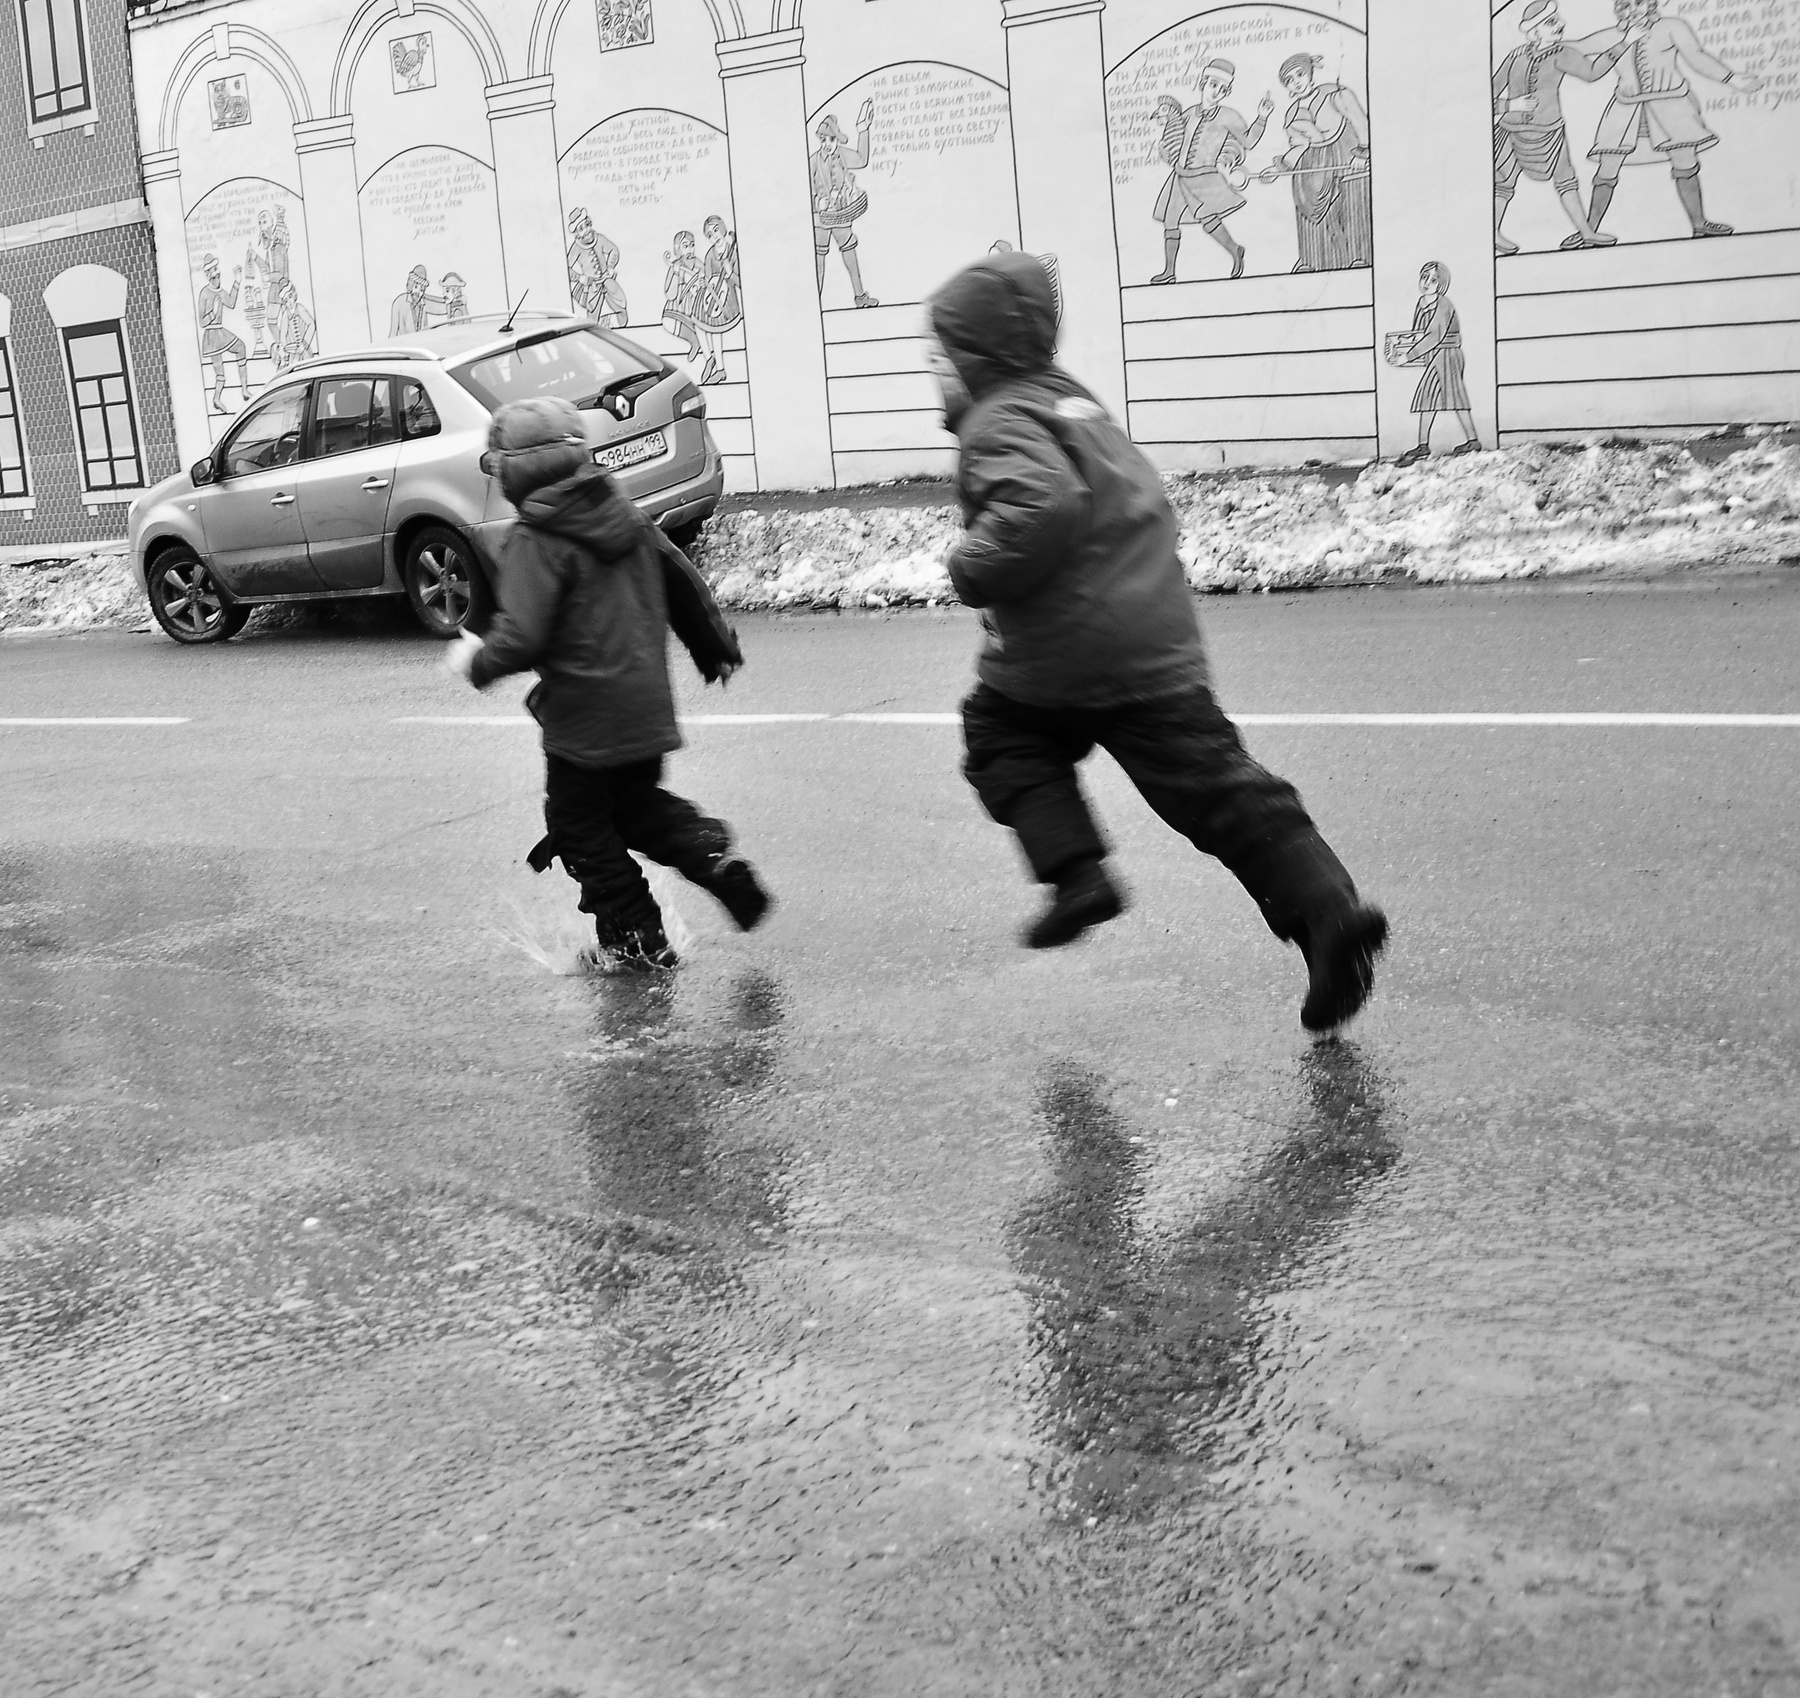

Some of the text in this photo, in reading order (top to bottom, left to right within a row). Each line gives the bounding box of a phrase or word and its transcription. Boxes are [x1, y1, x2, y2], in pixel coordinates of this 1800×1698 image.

[1195, 13, 1273, 37] КАШИРСКОЙ
[1698, 10, 1752, 30] ДОМА
[1761, 5, 1785, 20] НИ
[1703, 20, 1786, 46] НИ СЮДА
[1142, 21, 1330, 67] УЛИЦЕ МУЖИКИ ЛЮБЯТ В ГОС
[1719, 43, 1765, 59] ЛЬШЕ
[1114, 71, 1130, 81] ТИ
[1745, 58, 1767, 73] НЕ
[892, 70, 931, 85] БАБЬЕМ
[1109, 73, 1200, 96] СОСЕДОК КАШУ
[1763, 72, 1799, 88] ТАК
[875, 77, 974, 101] РЫНКЕ ЗАМОРСКИЕ
[876, 90, 992, 115] ГОСТИ СО ВСЯКИМ ТОВА
[1746, 94, 1757, 107] И
[628, 111, 670, 134] ЖИТНОЙ
[902, 110, 945, 126] ОТДАЮТ
[949, 108, 965, 118] ВСЕ
[969, 103, 1009, 118] ЗАДАРОМ
[586, 122, 693, 146] ПЛОЩАДИ ВЕСЬ ЛЮД ГО
[918, 127, 930, 137] СО
[934, 123, 963, 136] ВСЕГО
[573, 146, 610, 162] РОДСКОЙ
[672, 137, 686, 149] ДА
[696, 132, 718, 144] ПЛЯС
[871, 133, 996, 158] ДА ТОЛЬКО ОХОТНИКОВ
[1123, 143, 1136, 153] ТЕ
[1140, 139, 1157, 160] ИХ
[627, 155, 662, 167] ГОРОДЕ
[664, 150, 691, 162] ТИШЬ
[696, 146, 710, 159] ДА
[1114, 156, 1161, 170] РОГАТИН
[628, 167, 662, 180] ОТЧЕГО
[676, 163, 689, 174] НЕ
[618, 181, 656, 195] ПЕТЬ НЕ
[644, 433, 662, 449] 199
